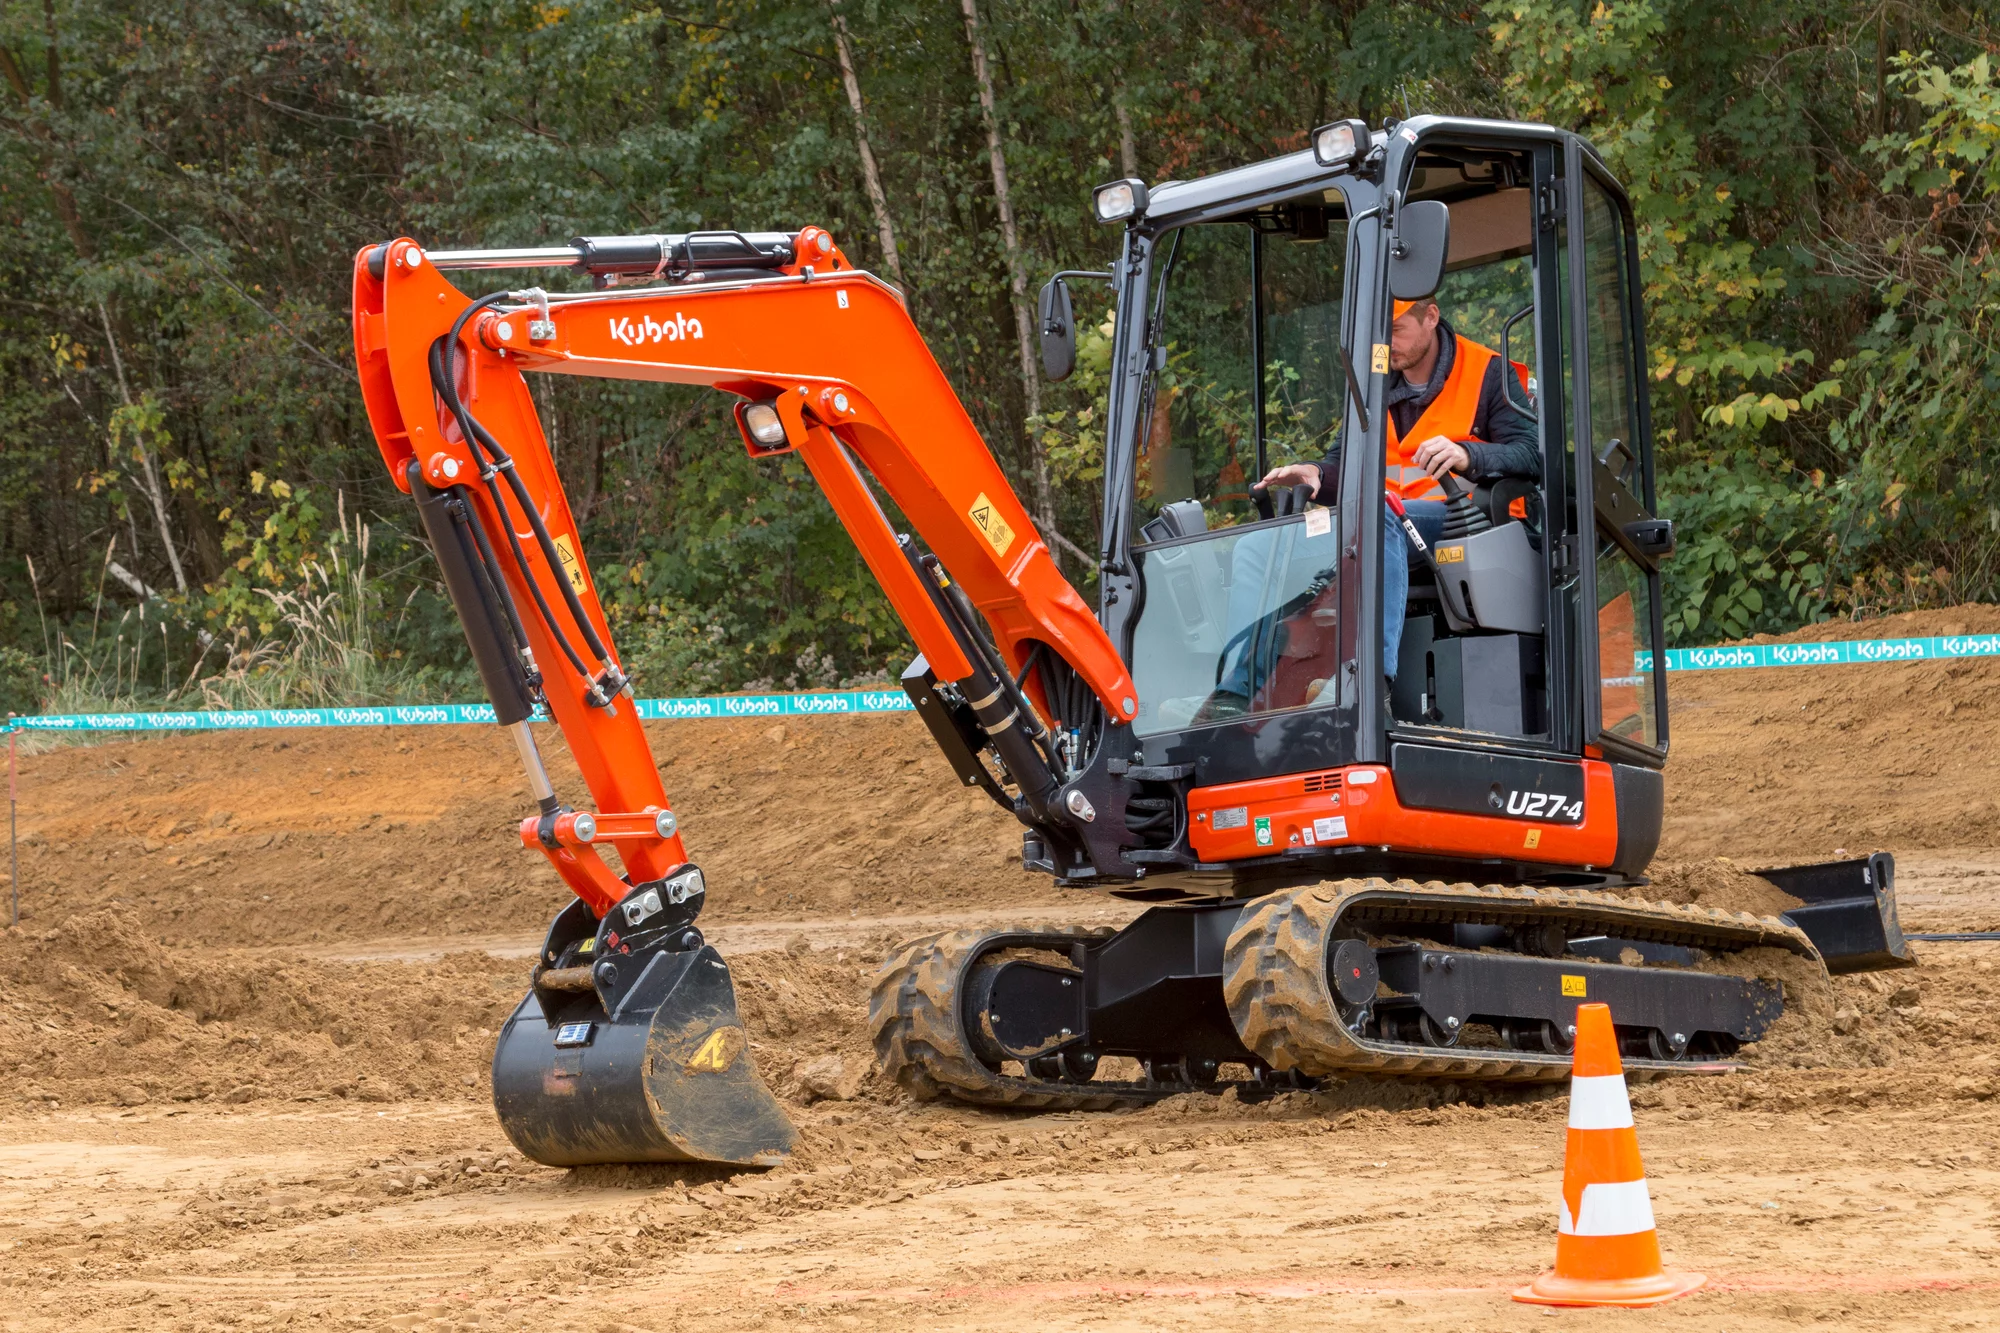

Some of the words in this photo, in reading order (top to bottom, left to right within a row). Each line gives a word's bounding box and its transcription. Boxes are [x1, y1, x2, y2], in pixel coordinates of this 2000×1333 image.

[609, 312, 703, 345] Kubota
[1690, 648, 1754, 666] Kubota
[1774, 645, 1838, 663] Kubota
[1858, 642, 1923, 660] Kubota
[1943, 636, 2000, 654] Kubot
[26, 717, 74, 727] Kubota
[87, 715, 135, 727] Kubota
[148, 713, 196, 727] Kubota
[209, 711, 258, 726] Kubota
[270, 710, 321, 725] Kubota
[334, 709, 384, 723] Kubota
[397, 707, 448, 722] Kubota
[460, 706, 497, 720] Kubo
[659, 700, 711, 715] Kubota
[726, 698, 779, 713] Kubota
[794, 696, 848, 711] Kubota
[1507, 791, 1583, 820] U27-4
